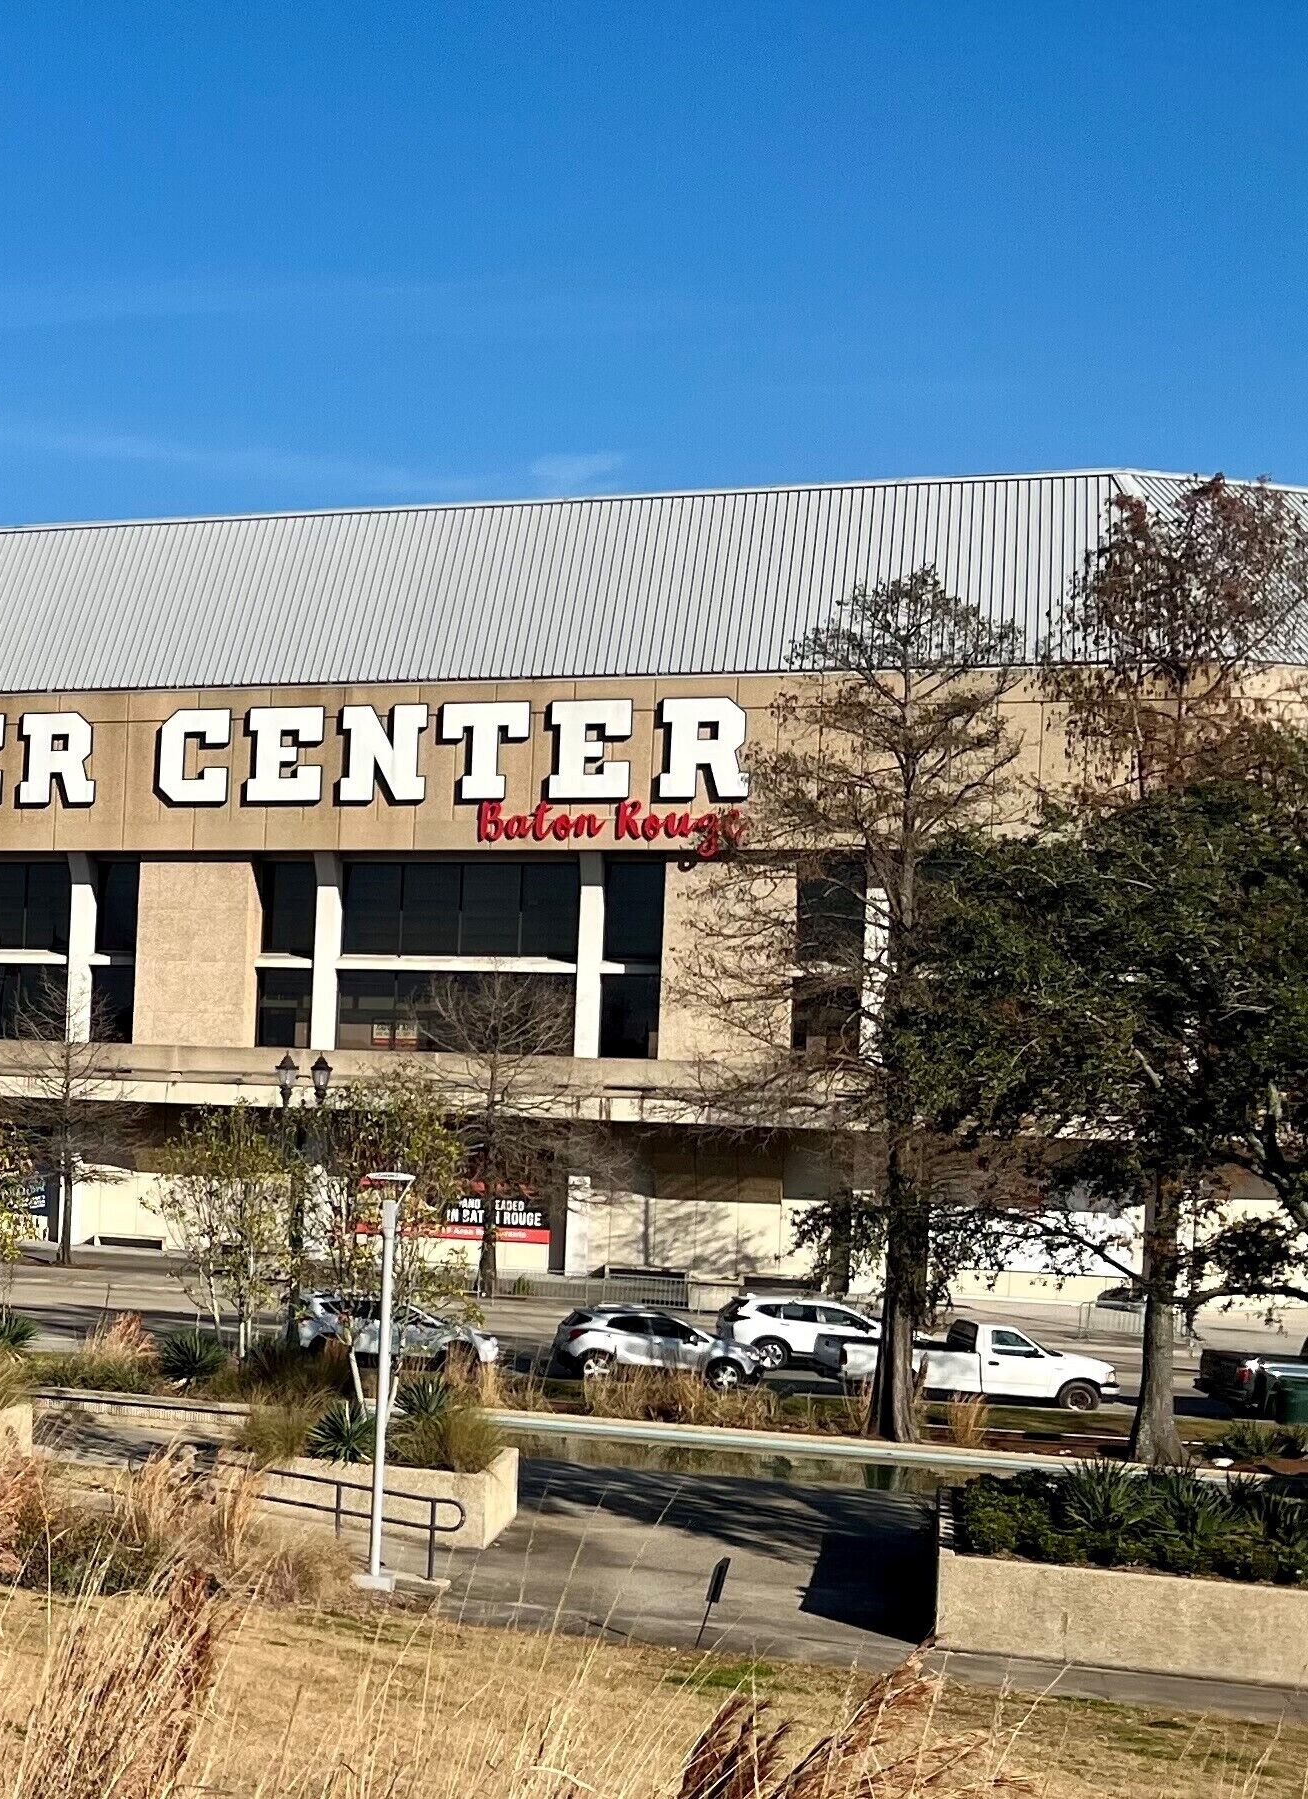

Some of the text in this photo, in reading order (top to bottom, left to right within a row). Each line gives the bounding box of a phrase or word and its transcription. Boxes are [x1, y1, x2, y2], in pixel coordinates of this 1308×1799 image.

[155, 696, 750, 806] CENTER
[477, 799, 606, 842] Baton
[503, 1210, 543, 1227] ROUGE
